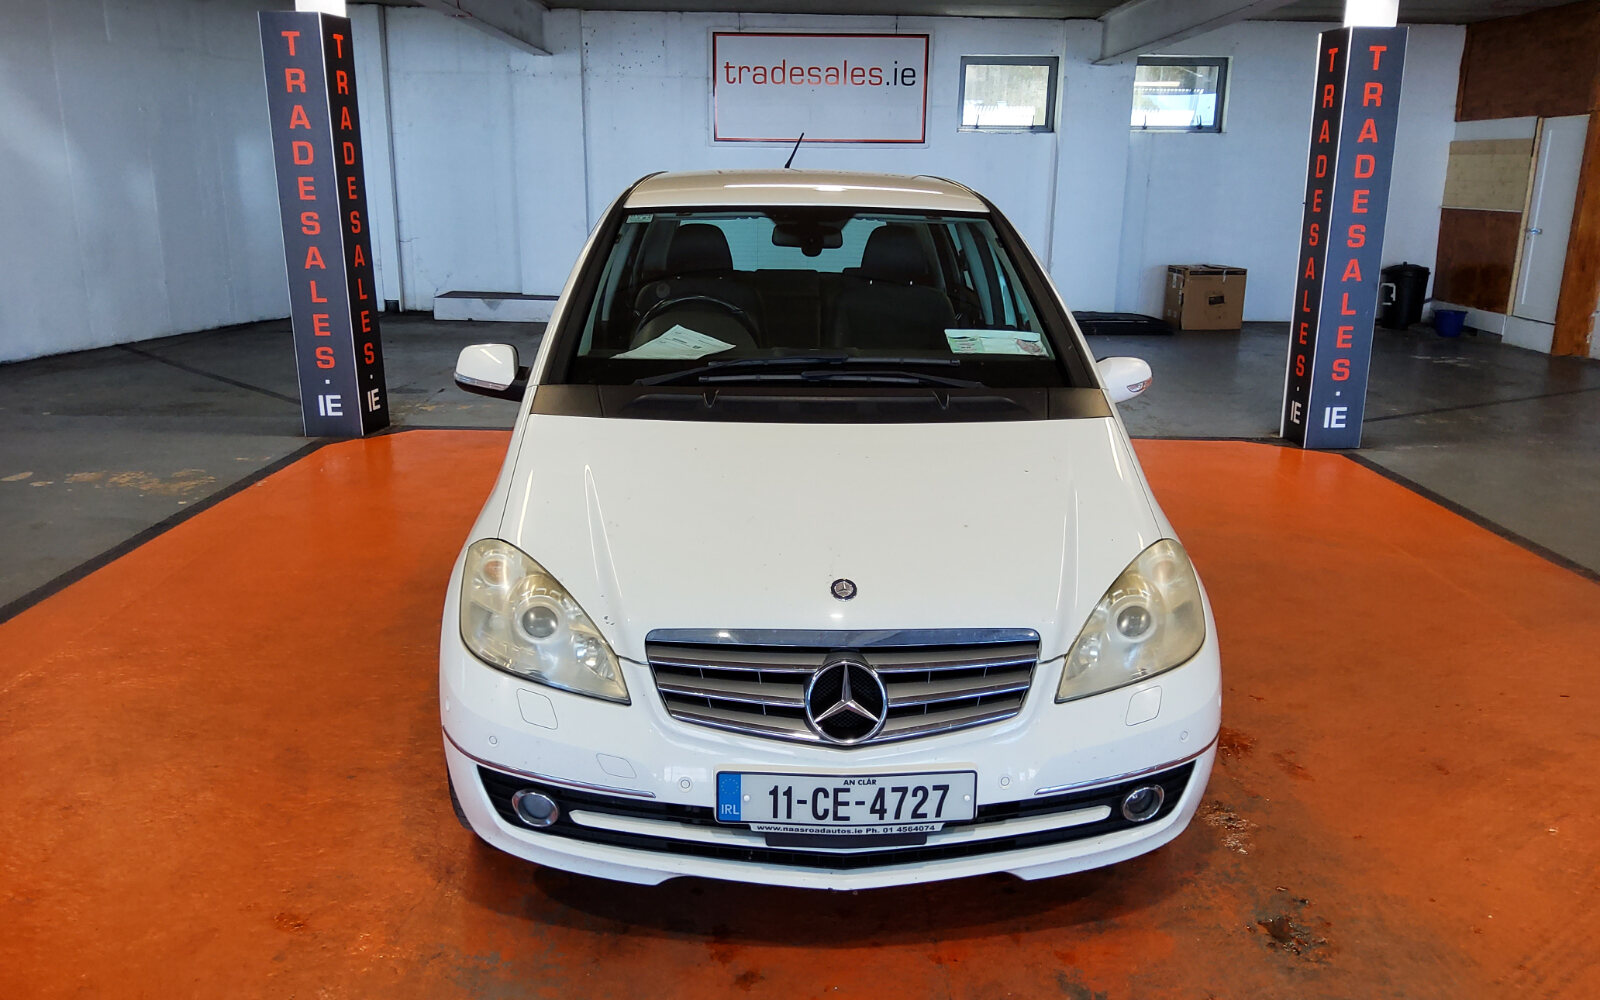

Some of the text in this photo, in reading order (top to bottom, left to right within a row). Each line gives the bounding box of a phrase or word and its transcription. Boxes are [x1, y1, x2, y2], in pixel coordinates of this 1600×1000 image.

[724, 59, 916, 86] tradesales.ie
[857, 778, 877, 786] CLÁR
[768, 785, 950, 821] 11-CE-4727
[721, 804, 739, 815] IRL
[757, 824, 935, 835] www.naasroadautos.ie Ph. 01 4564074
